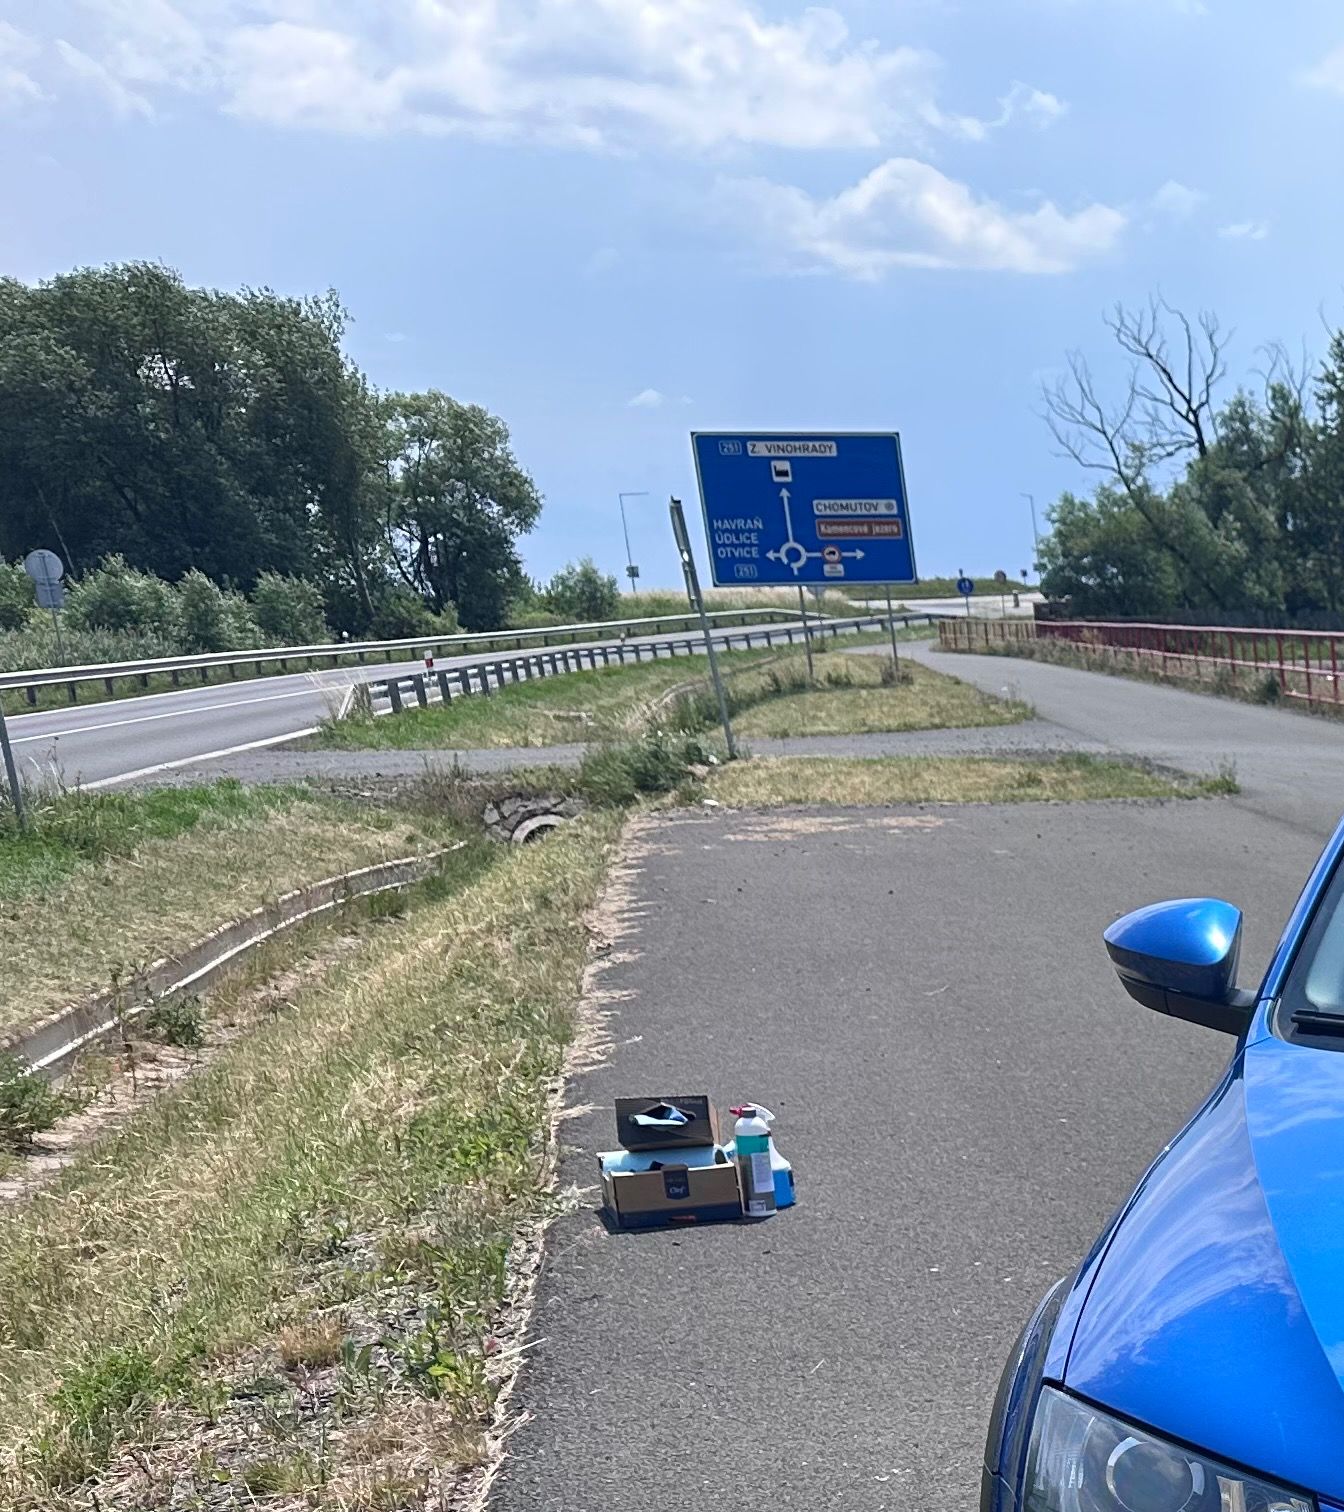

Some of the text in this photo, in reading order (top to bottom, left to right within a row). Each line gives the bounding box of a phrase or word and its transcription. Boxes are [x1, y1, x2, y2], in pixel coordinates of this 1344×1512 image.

[764, 444, 834, 454] VINOHRADY
[815, 502, 879, 512] CHOMUTOV
[713, 516, 763, 530] HAVRAŇ
[717, 546, 759, 558] OTVICE
